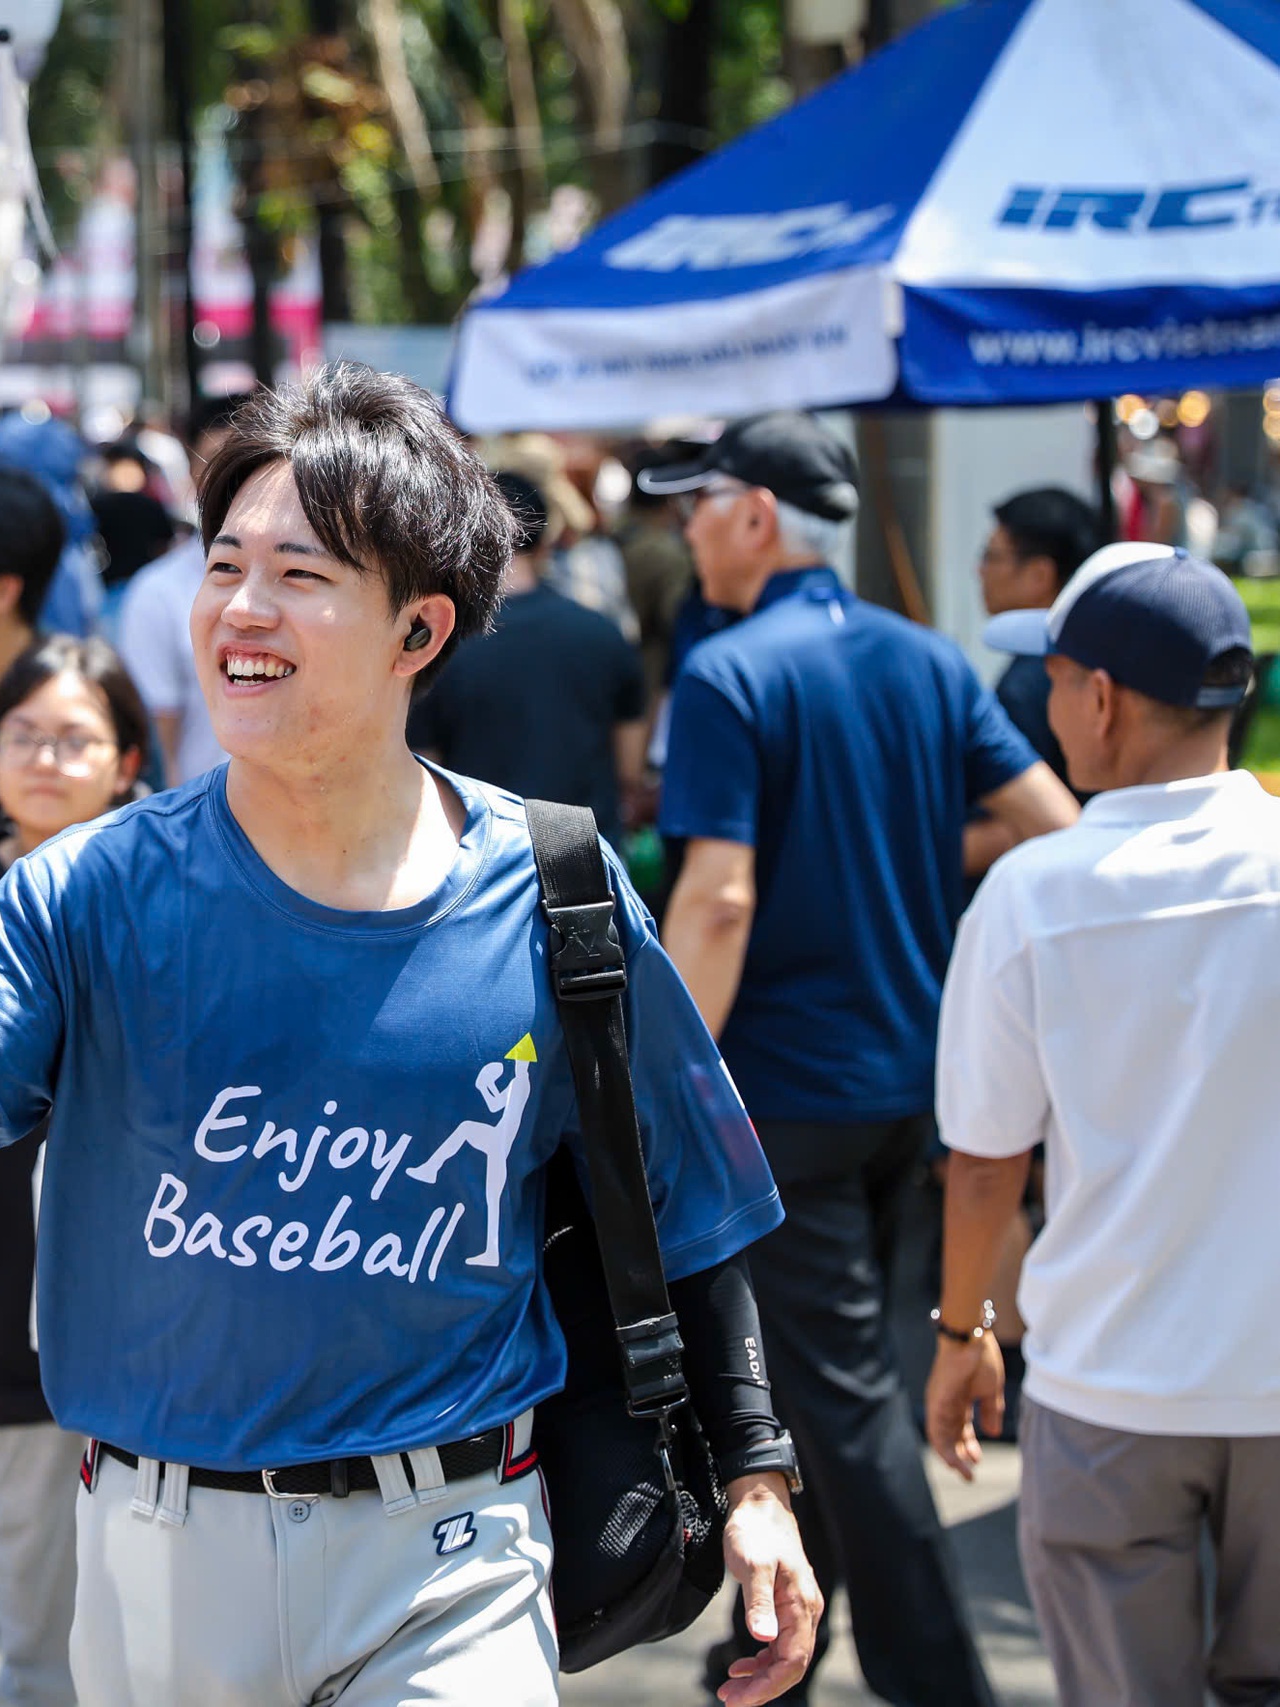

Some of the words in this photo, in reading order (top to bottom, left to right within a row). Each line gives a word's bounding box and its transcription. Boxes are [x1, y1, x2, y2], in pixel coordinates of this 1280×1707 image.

[996, 178, 1250, 232] IRC
[194, 1086, 413, 1200] Enjoy
[144, 1173, 466, 1283] Baseball
